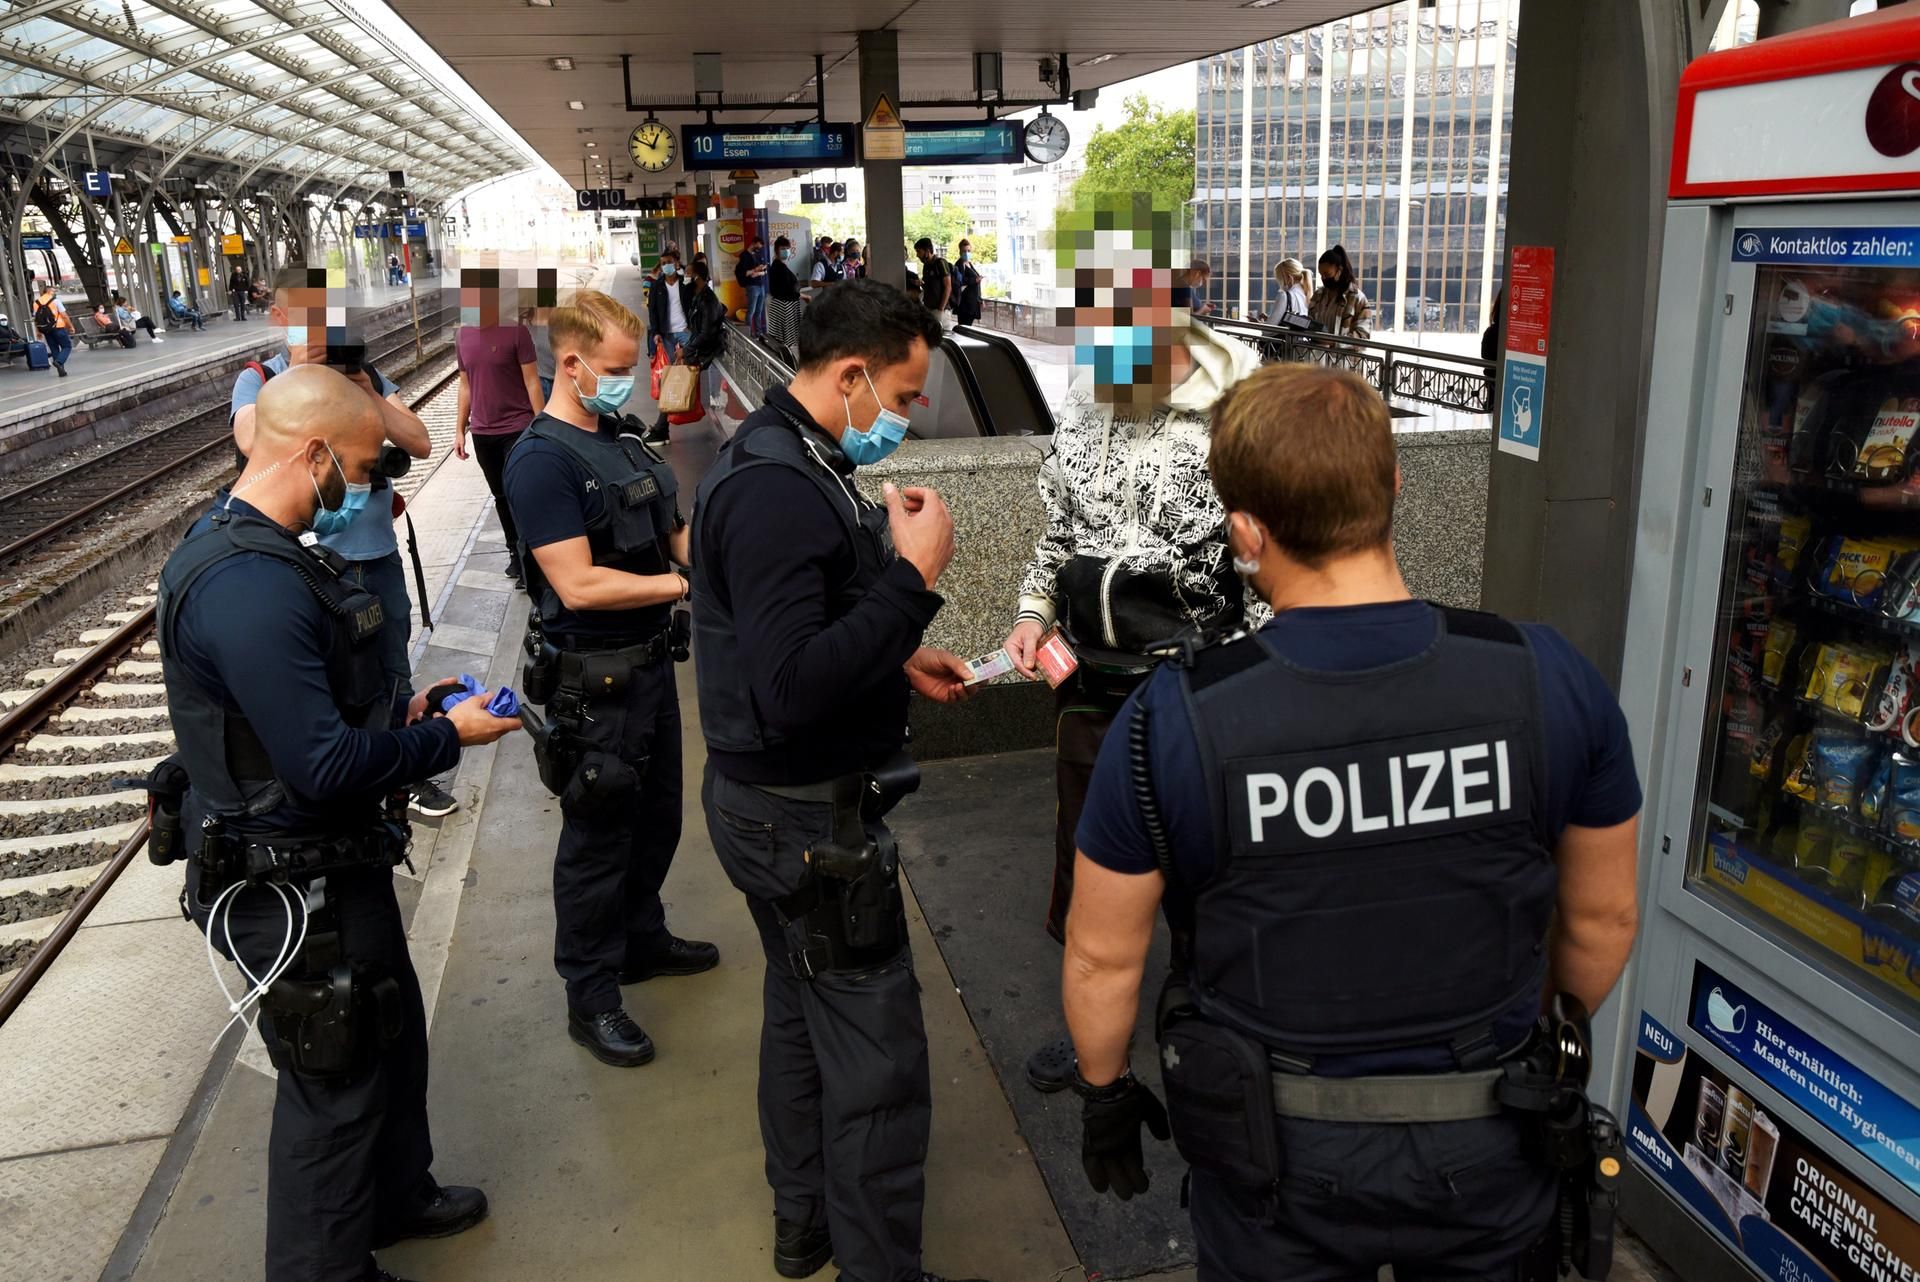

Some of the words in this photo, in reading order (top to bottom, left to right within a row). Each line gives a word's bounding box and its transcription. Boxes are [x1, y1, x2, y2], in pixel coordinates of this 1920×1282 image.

[694, 136, 713, 153] 10
[828, 135, 833, 143] S
[836, 134, 843, 143] 6
[998, 131, 1014, 148] 11
[723, 148, 750, 157] Essen
[85, 172, 101, 191] E
[810, 185, 824, 199] 11
[833, 184, 845, 199] C
[579, 190, 592, 207] C
[601, 190, 620, 207] 10
[409, 208, 416, 216] F
[721, 235, 742, 243] Lipton
[1769, 236, 1848, 255] Kontaktlos
[1851, 236, 1914, 256] zahlen:
[1874, 415, 1915, 428] nutella
[627, 478, 657, 500] POLIZEI
[1862, 554, 1881, 564] UP!
[355, 603, 384, 633] POLIZEI
[1246, 740, 1512, 842] POLIZEI
[1714, 853, 1746, 882] Prinzen
[1645, 1022, 1674, 1055] NEU!
[1755, 1020, 1787, 1050] Hier
[1786, 1045, 1863, 1106] erhältlich:
[1752, 1039, 1807, 1088] Masken
[1808, 1081, 1838, 1111] und
[1632, 1125, 1673, 1170] LAVAZZA
[1796, 1157, 1879, 1235] ORIGINAL
[1781, 1253, 1801, 1280] HOL
